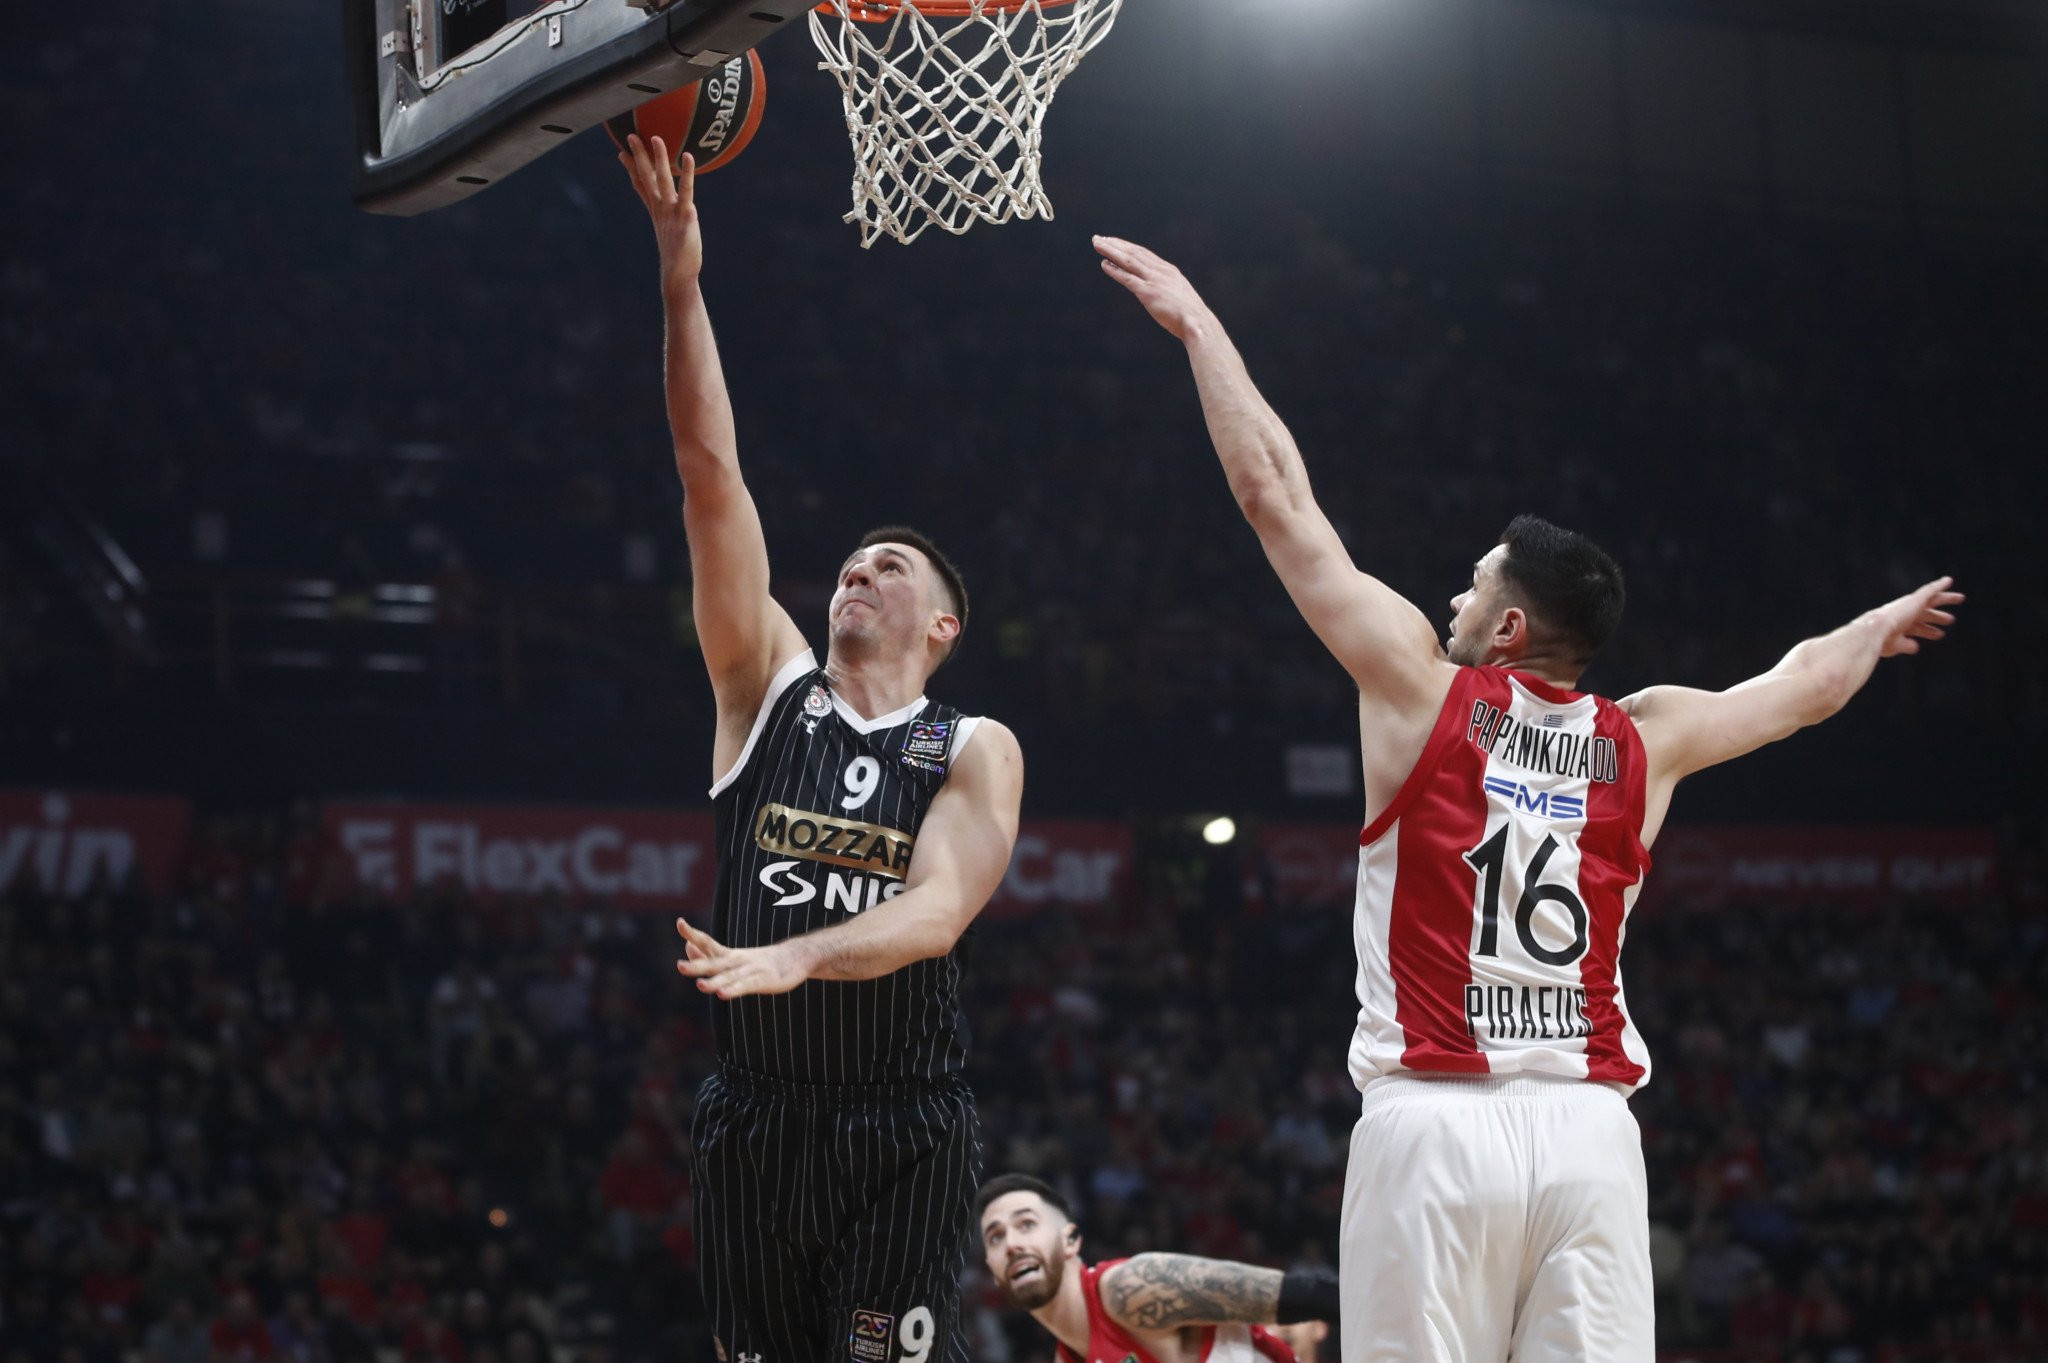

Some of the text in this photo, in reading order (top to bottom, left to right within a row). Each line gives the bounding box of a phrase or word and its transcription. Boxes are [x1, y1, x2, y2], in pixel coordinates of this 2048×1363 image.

[901, 756, 945, 775] oneteam
[1467, 699, 1617, 784] PAPANIKOLAOU
[841, 755, 880, 810] 9
[413, 819, 701, 893] FlexCar
[1462, 820, 1590, 967] 16
[1464, 984, 1594, 1040] PIRAEUS
[854, 1314, 889, 1339] 25
[854, 1337, 886, 1349] TURKISH
[854, 1344, 886, 1356] AIRLINES
[897, 1305, 936, 1363] 9
